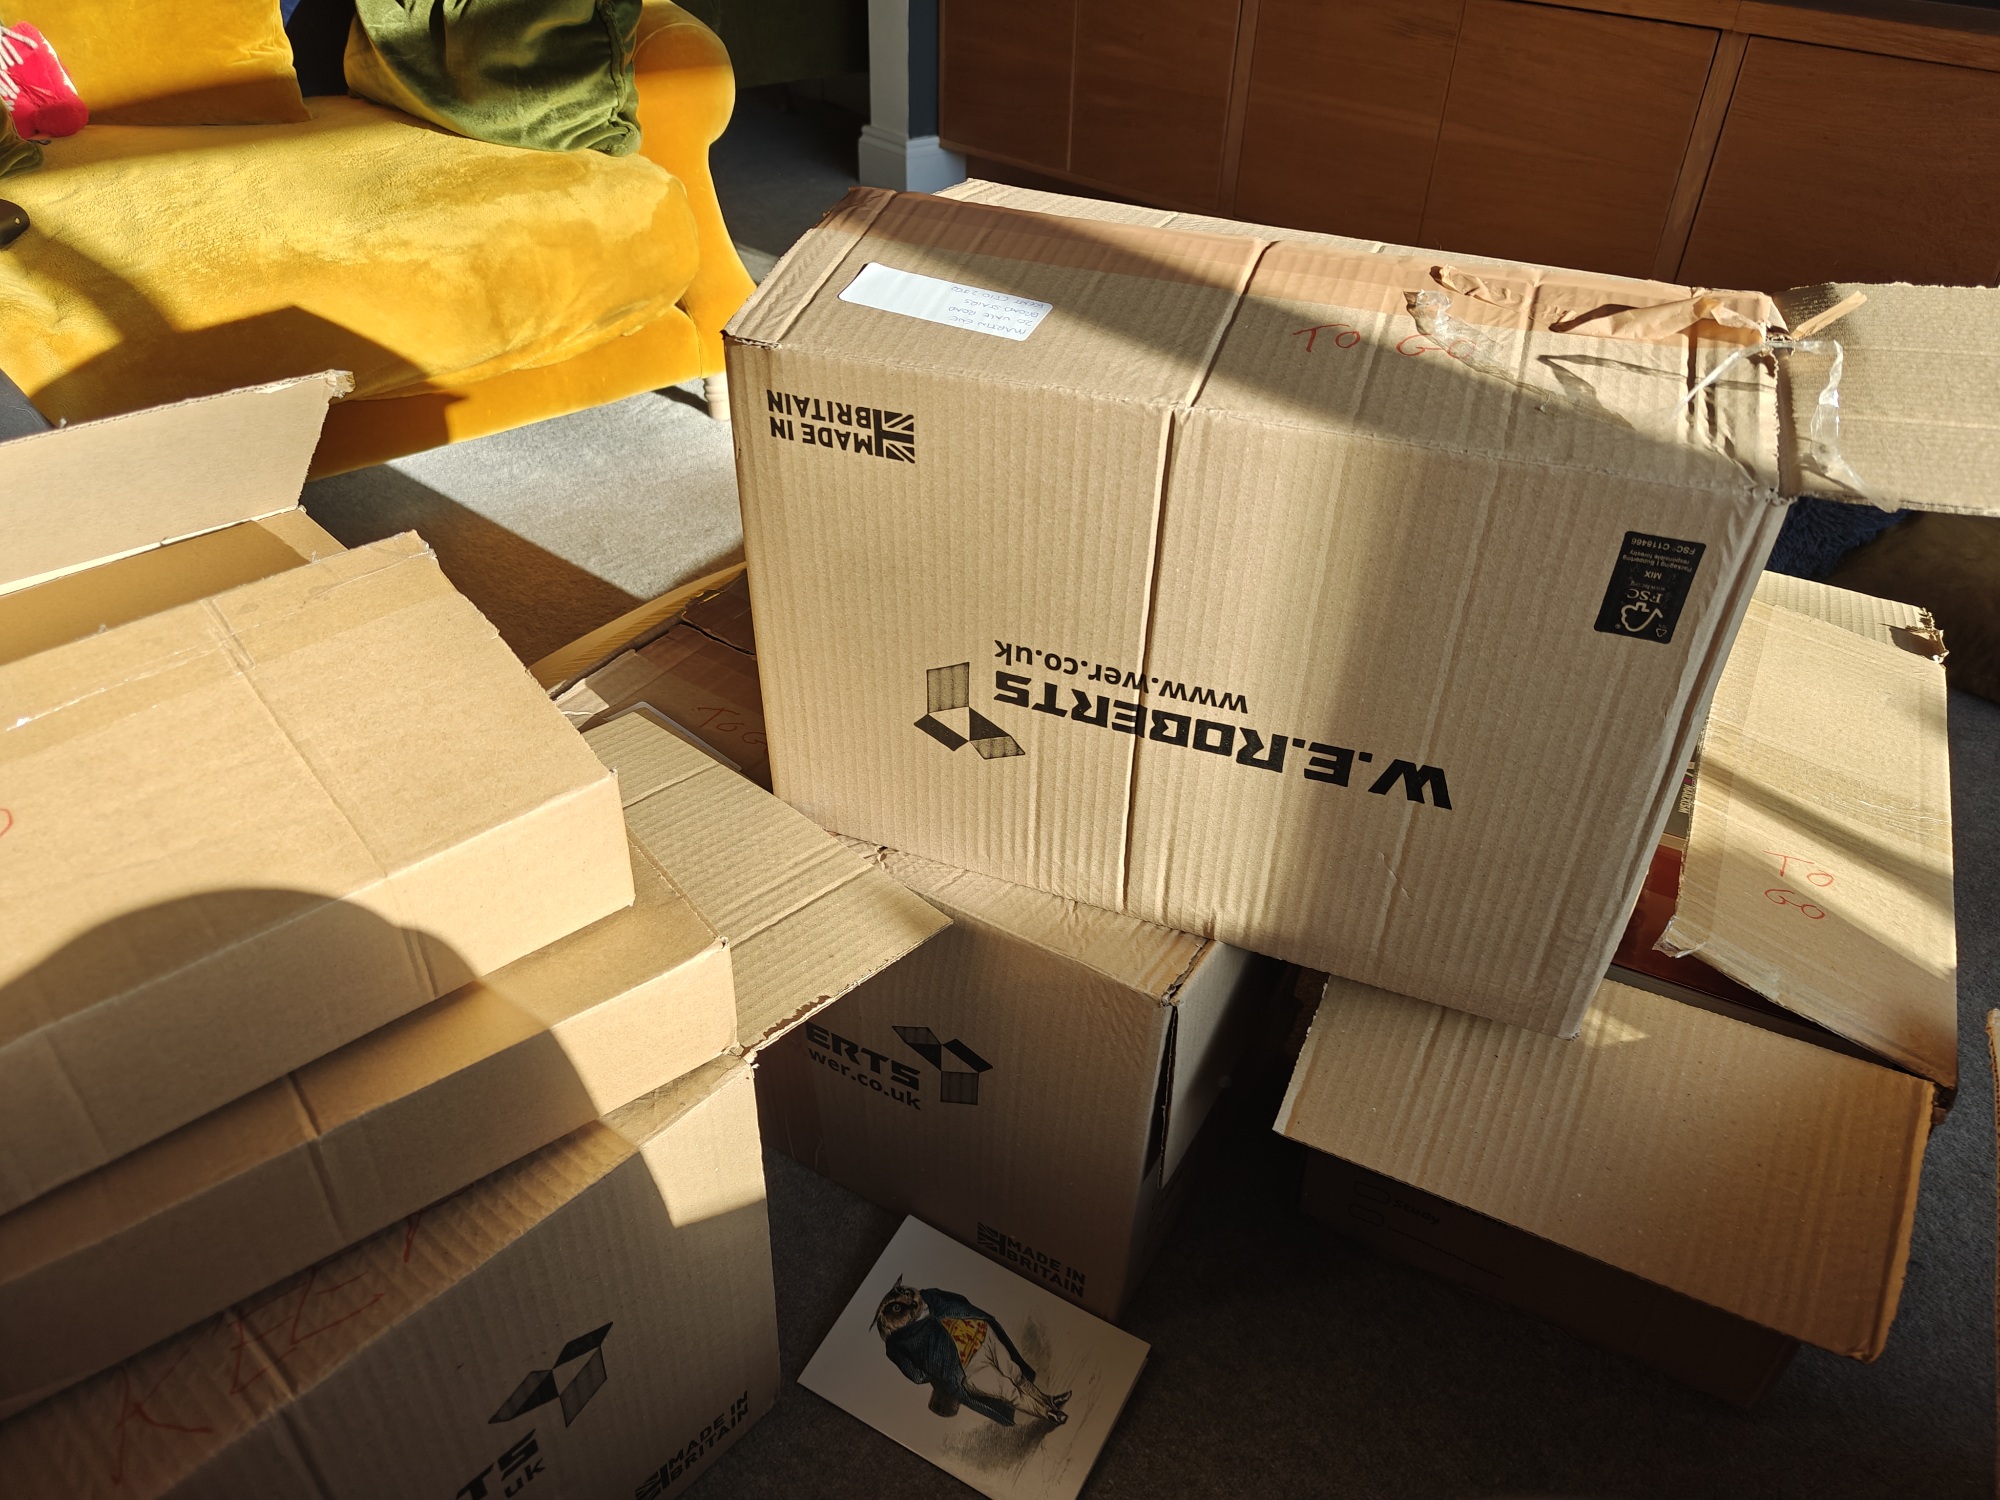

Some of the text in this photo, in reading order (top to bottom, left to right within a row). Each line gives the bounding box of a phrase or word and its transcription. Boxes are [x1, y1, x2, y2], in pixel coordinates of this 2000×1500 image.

[948, 306, 976, 316] ROAD
[1014, 300, 1044, 309] KENT
[1292, 323, 1476, 360] TO GO
[766, 389, 872, 430] BRITAIN
[769, 416, 874, 456] MADE IN
[1644, 570, 1663, 580] MIX
[1627, 588, 1663, 604] FSC
[994, 639, 1248, 714] www.wer.co.uk
[697, 707, 745, 733] TO
[994, 670, 1453, 810] W.E.ROBERTS
[1762, 850, 1834, 887] TO
[1764, 888, 1826, 920] GO
[1004, 1250, 1085, 1298] BRITAIN
[1006, 1235, 1086, 1286] MADE IN
[668, 1390, 748, 1470] MADE IN
[670, 1402, 749, 1483] BRITAIN
